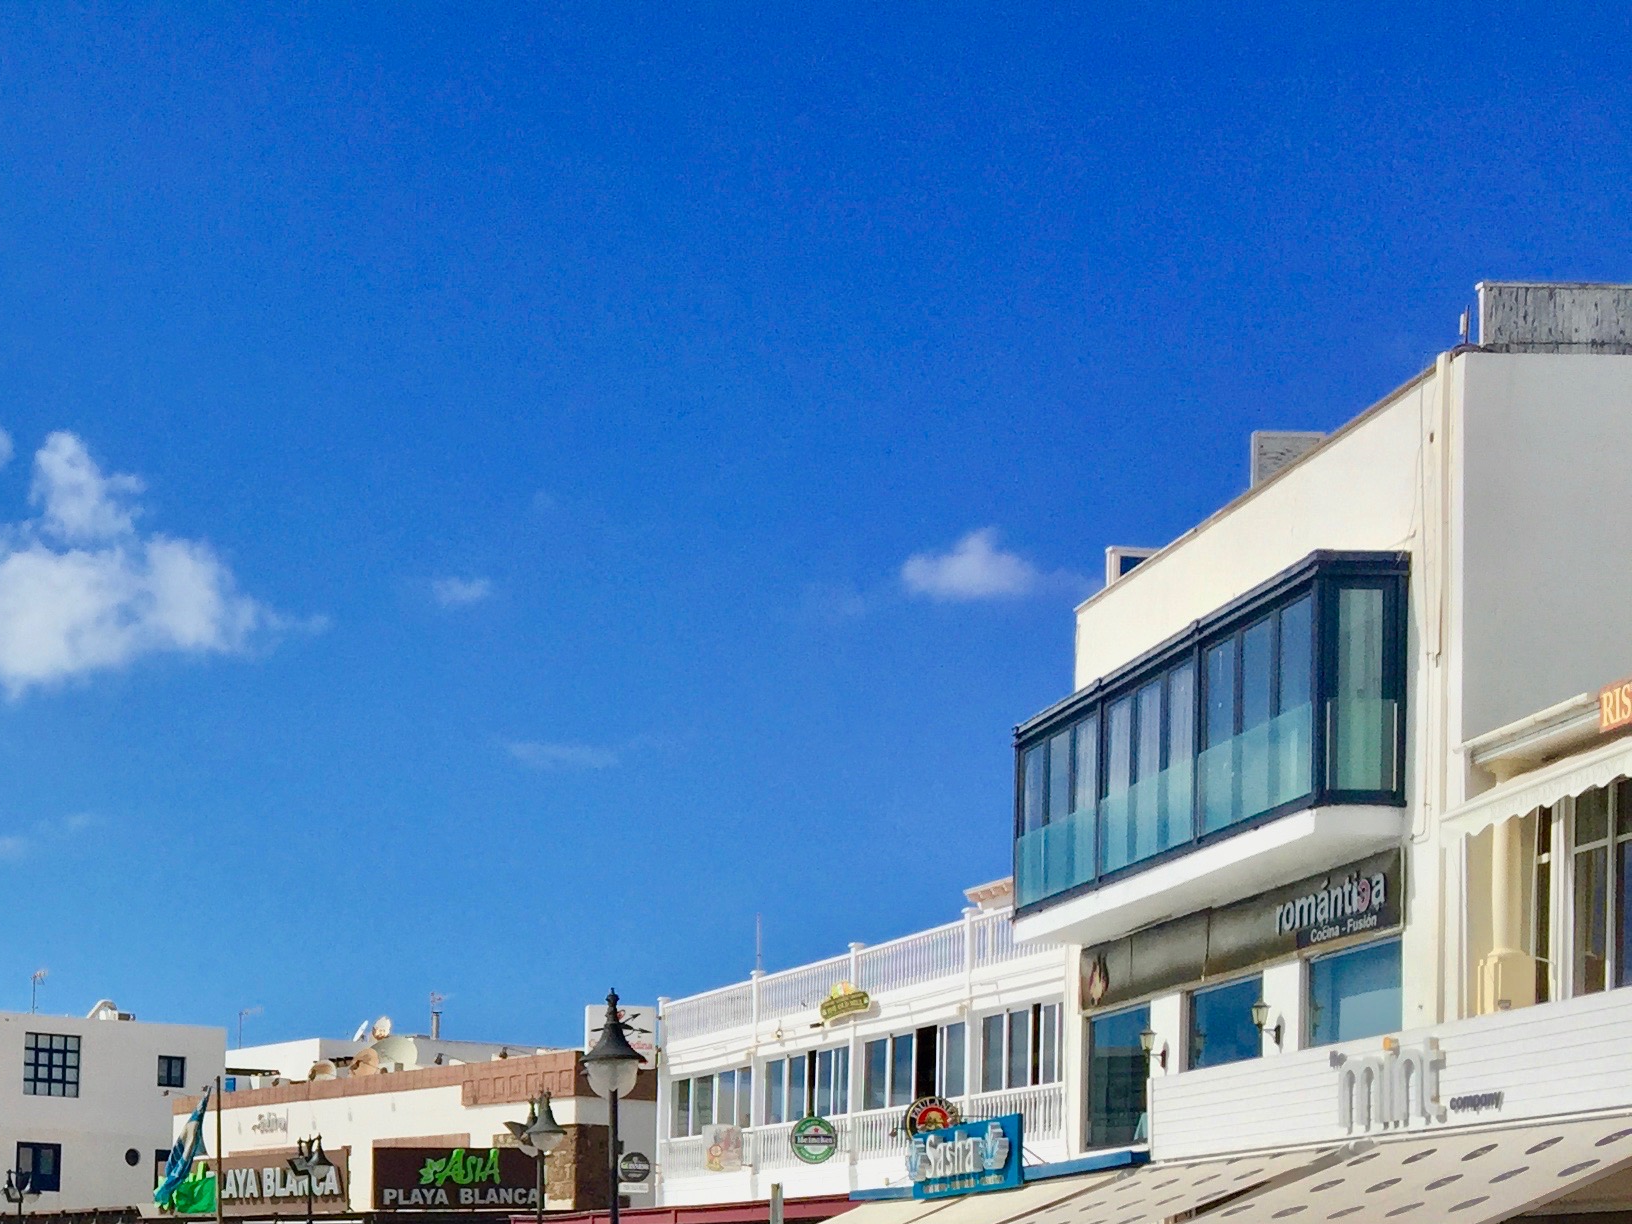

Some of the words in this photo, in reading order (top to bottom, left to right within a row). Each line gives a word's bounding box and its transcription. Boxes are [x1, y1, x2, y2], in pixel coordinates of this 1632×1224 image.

[1600, 681, 1632, 727] RIS
[1347, 913, 1378, 934] Fusión
[1338, 1036, 1447, 1132] mint
[925, 1130, 984, 1179] Sasha
[382, 1187, 450, 1206] PLAYA
[459, 1187, 539, 1205] BLANCA
